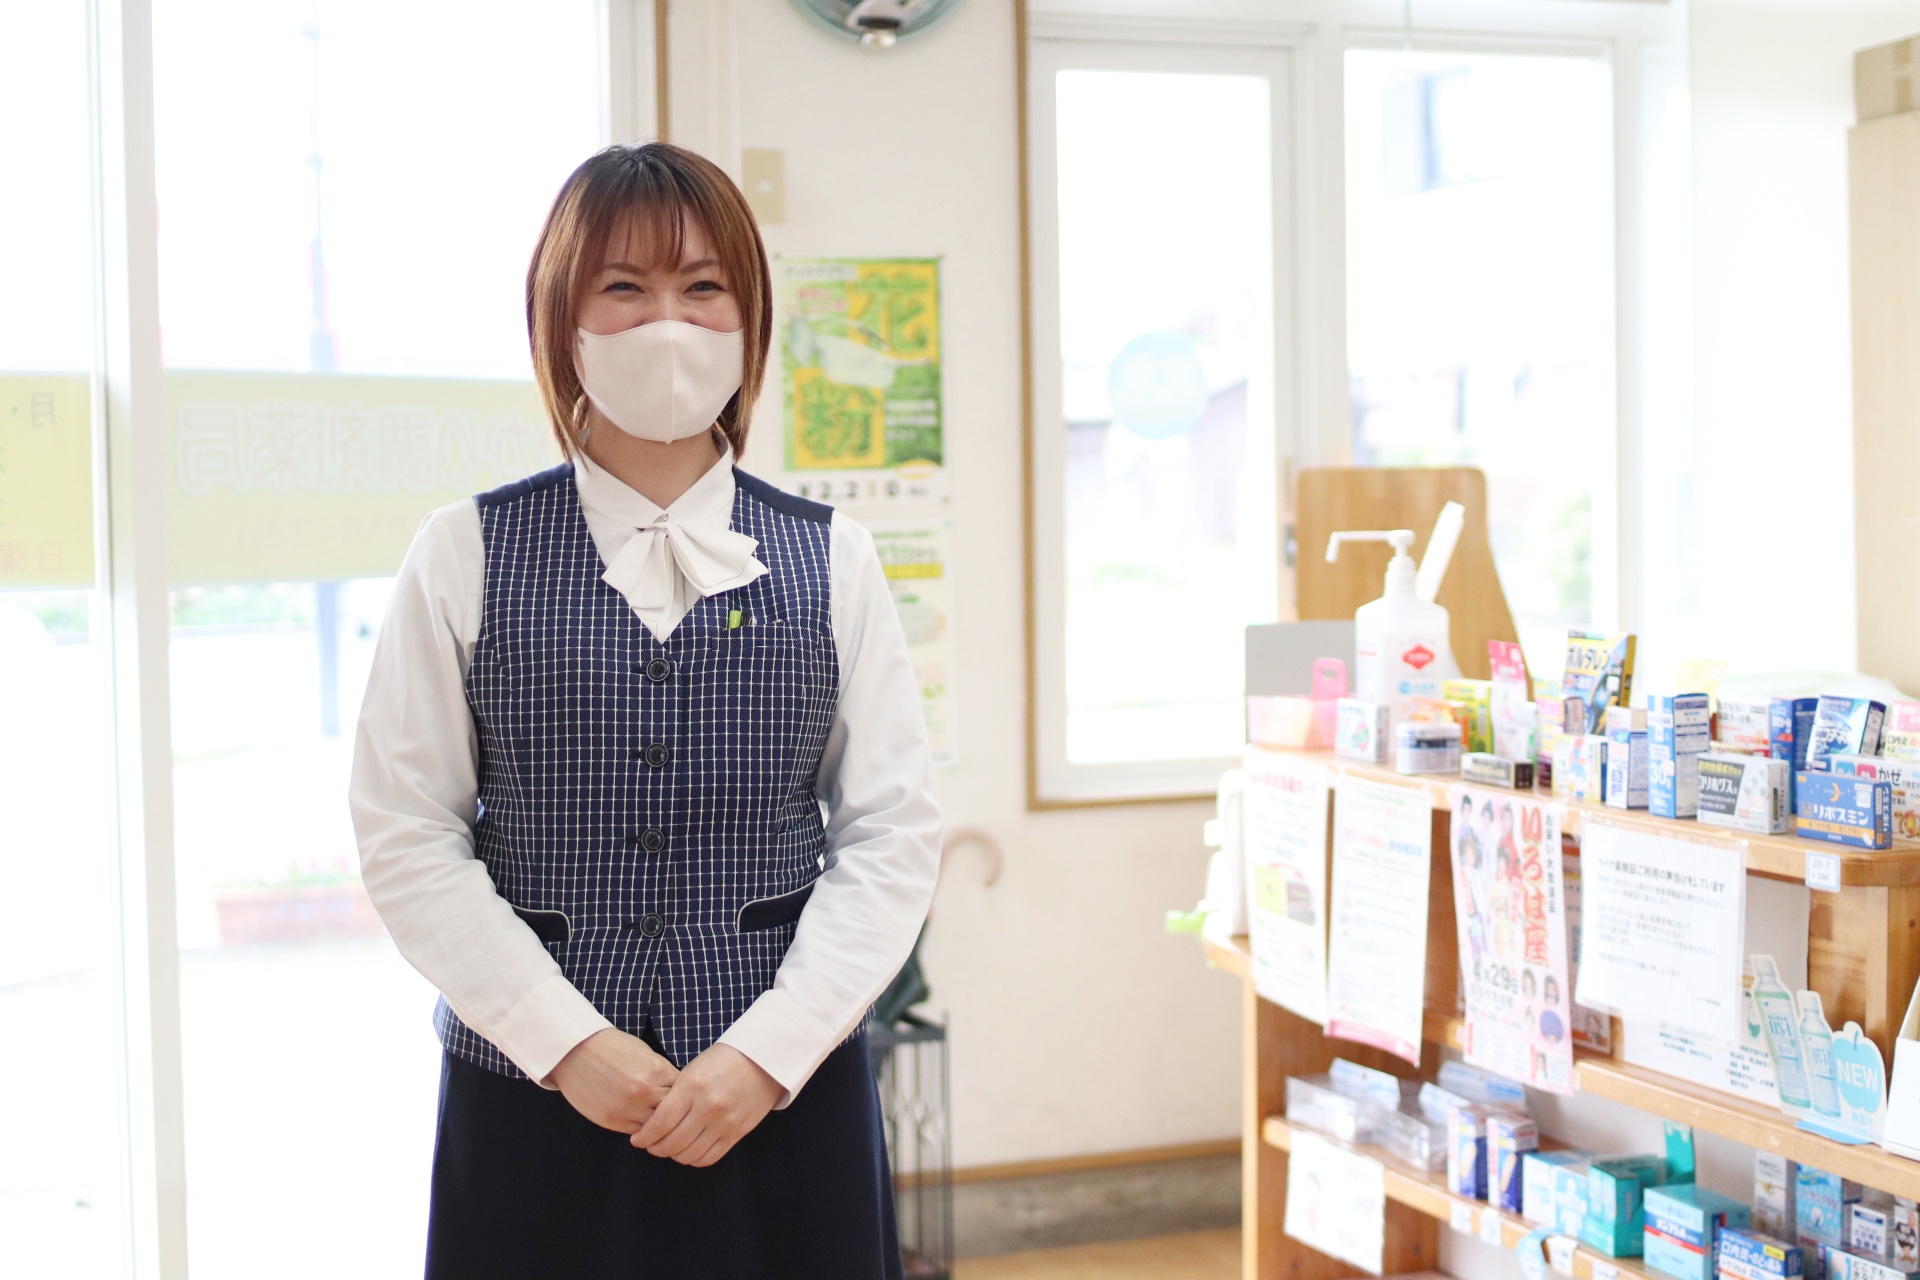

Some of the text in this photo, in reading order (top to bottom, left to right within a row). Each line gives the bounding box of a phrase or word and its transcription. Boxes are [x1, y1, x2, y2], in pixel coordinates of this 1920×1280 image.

[1814, 804, 1869, 826] リポスミン
[1836, 1059, 1879, 1093] NEW
